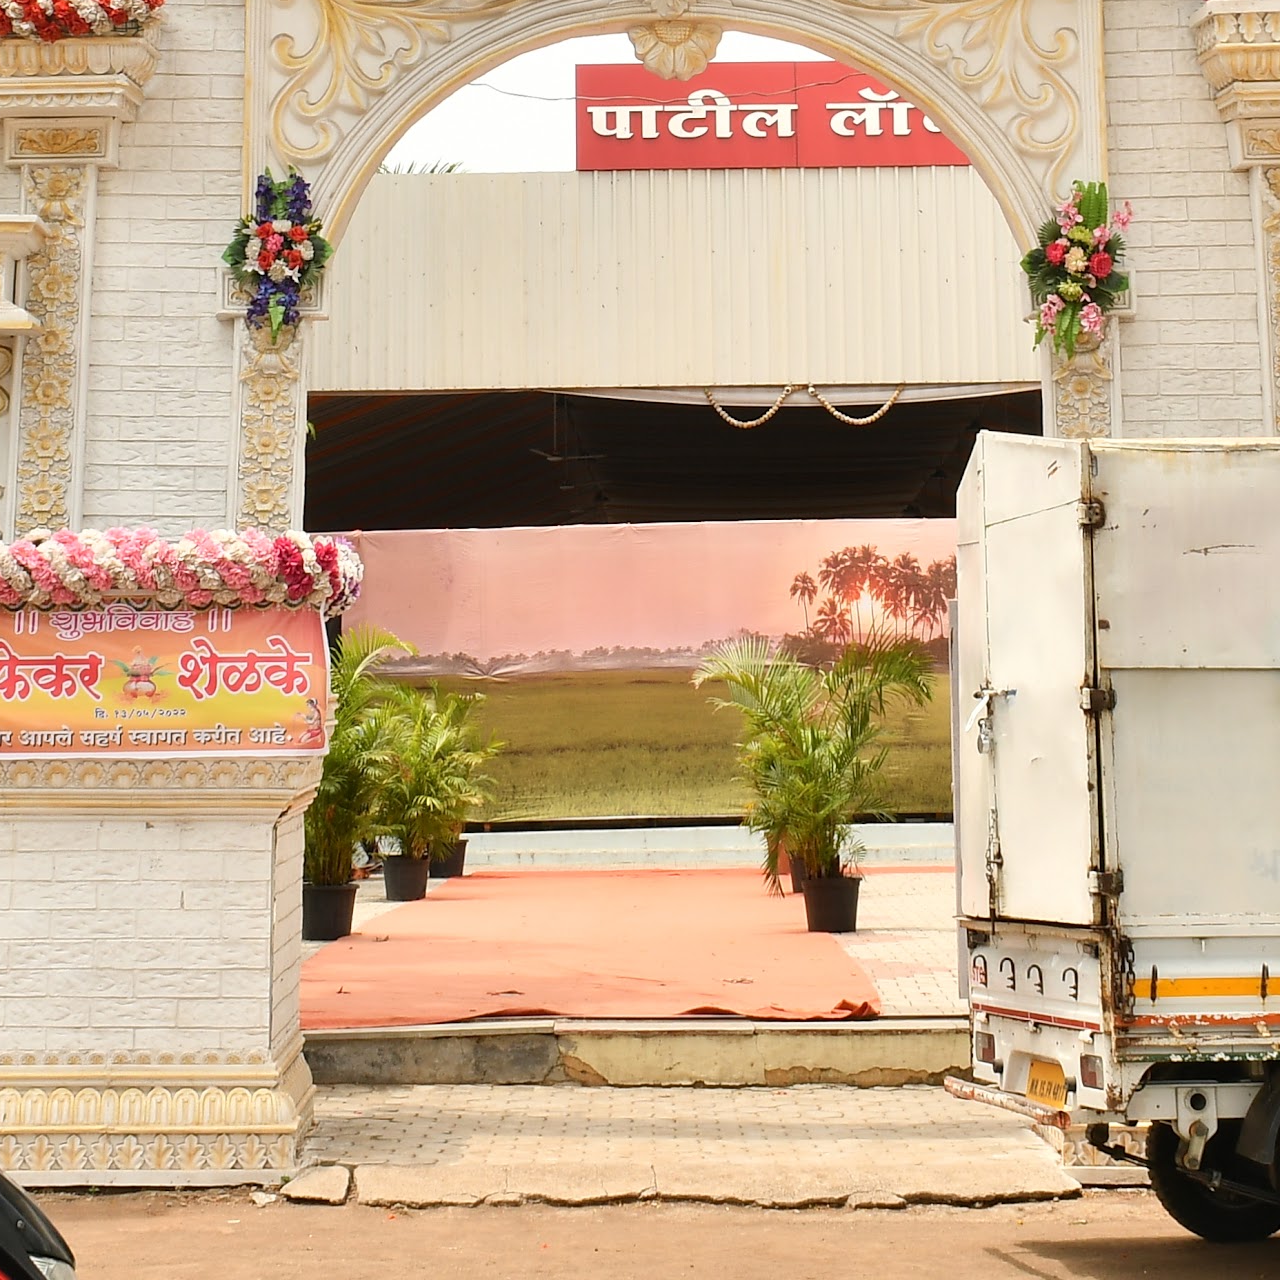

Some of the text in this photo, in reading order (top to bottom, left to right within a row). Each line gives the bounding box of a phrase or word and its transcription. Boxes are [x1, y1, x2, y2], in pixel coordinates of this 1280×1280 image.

[587, 89, 799, 139] पाटील
[51, 604, 195, 640] शुभविवाह
[179, 638, 312, 699] शेळके
[18, 724, 74, 746] आपले
[79, 724, 123, 747] सहर्ष
[128, 727, 188, 745] स्वागत
[192, 723, 242, 745] करीत
[248, 722, 293, 745] आहे.
